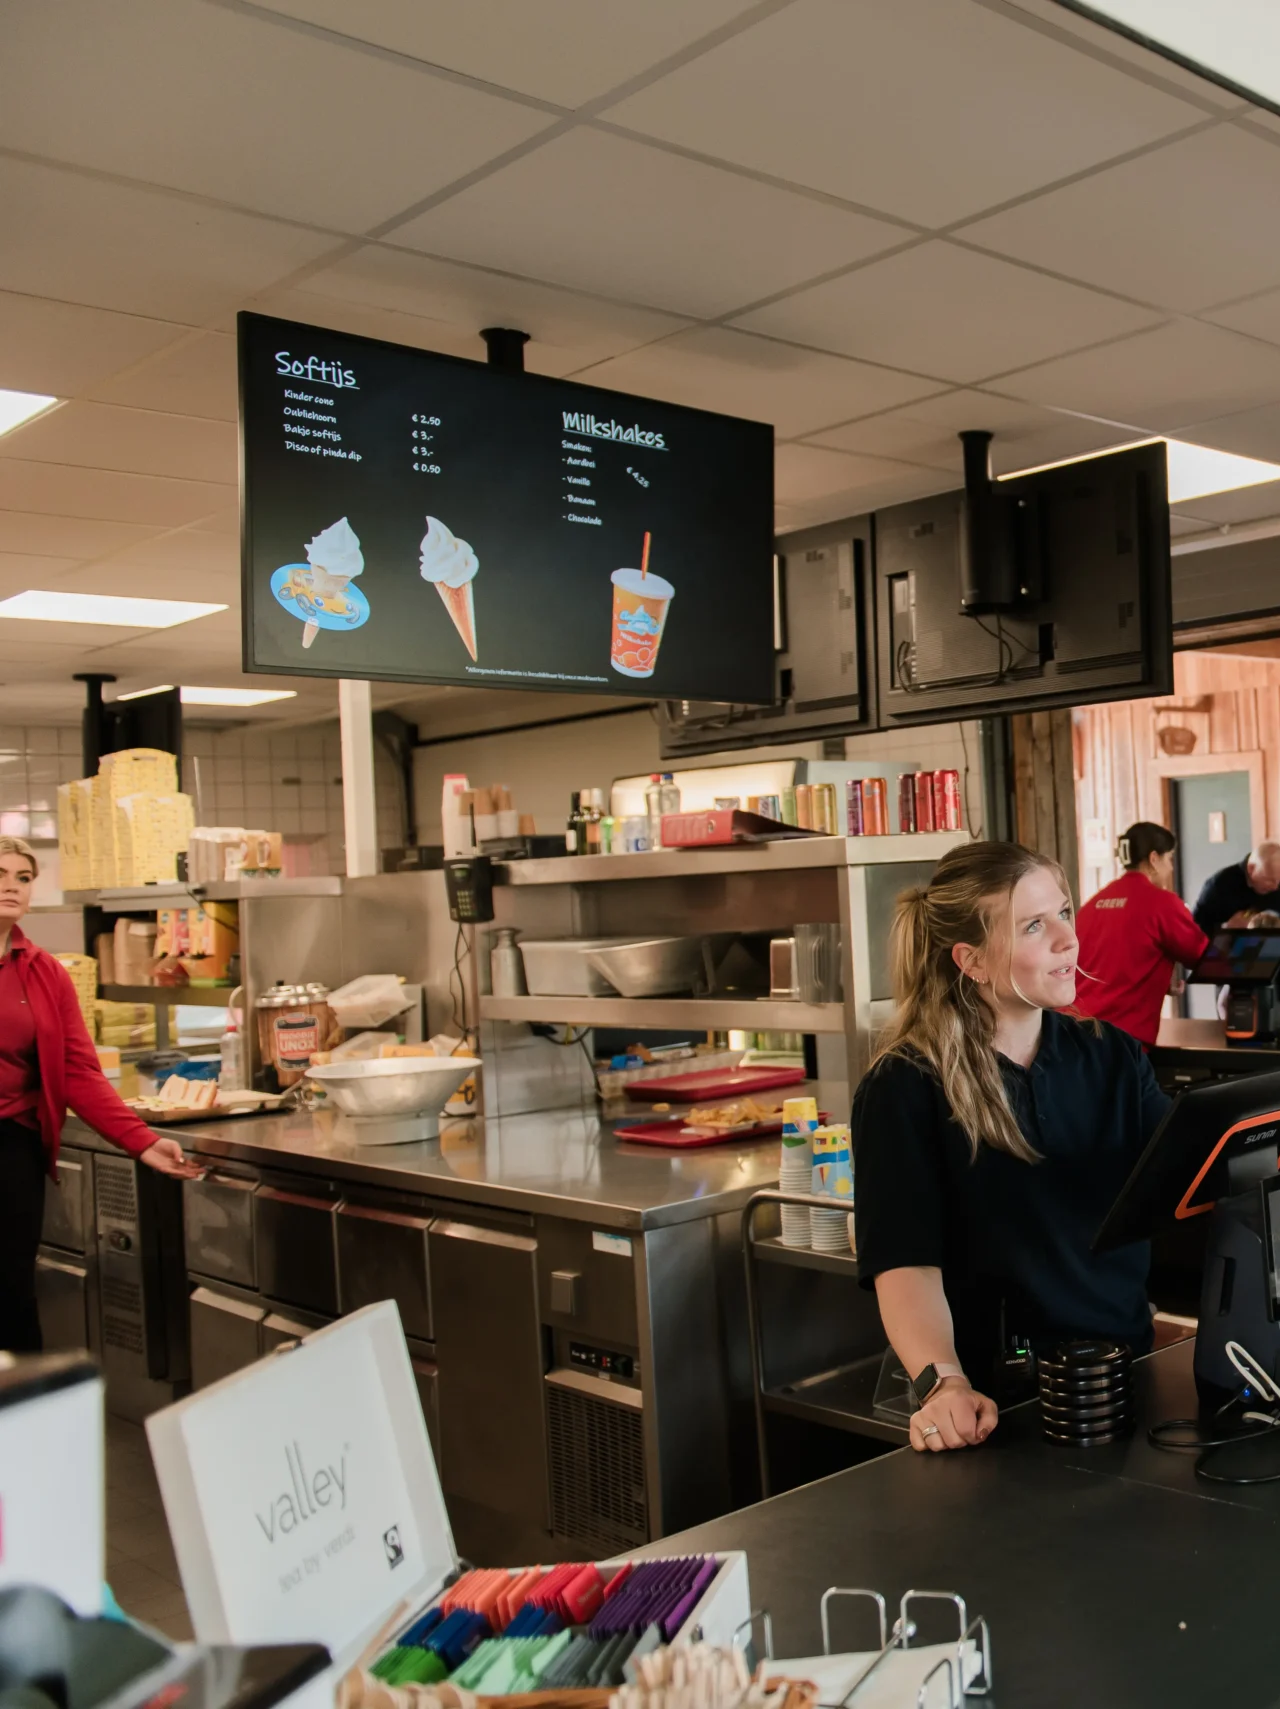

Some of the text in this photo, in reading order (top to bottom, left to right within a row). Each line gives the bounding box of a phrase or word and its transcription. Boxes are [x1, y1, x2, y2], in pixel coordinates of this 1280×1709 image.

[275, 351, 356, 388] Softijs
[284, 389, 334, 406] Kinder cone
[283, 407, 337, 423] Oubliehoorn
[412, 414, 418, 422] €
[283, 424, 342, 442] Bakje softijs
[412, 430, 418, 439] €
[563, 411, 665, 448] Milkshakes
[285, 441, 362, 462] Disco of pinda dip
[412, 446, 418, 455] €
[413, 462, 419, 471] €
[1095, 897, 1128, 909] CREW
[280, 1040, 316, 1052] UNOX
[255, 1439, 346, 1544] valley
